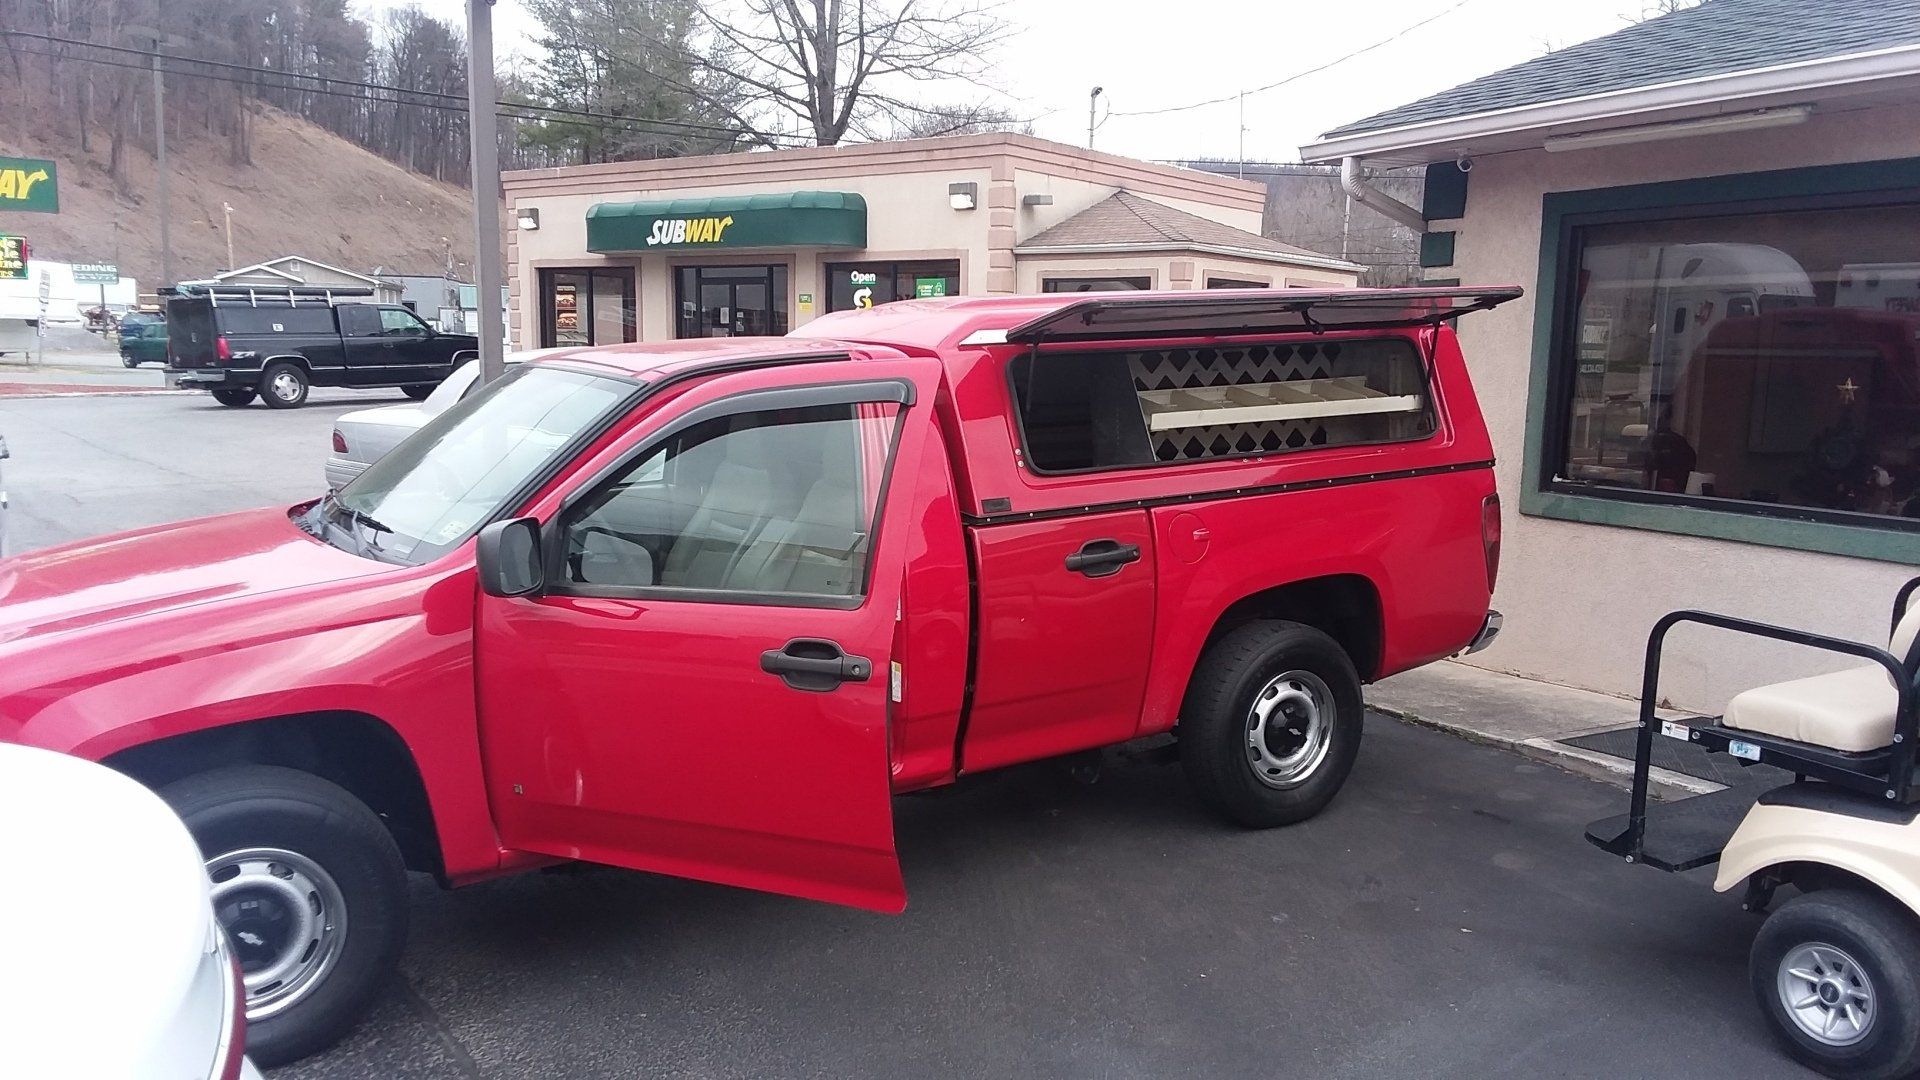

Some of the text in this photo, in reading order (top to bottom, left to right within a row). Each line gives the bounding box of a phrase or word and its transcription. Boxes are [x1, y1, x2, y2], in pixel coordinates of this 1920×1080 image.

[0, 169, 48, 199] AY
[646, 216, 734, 246] SUBWAY
[850, 270, 876, 285] Open
